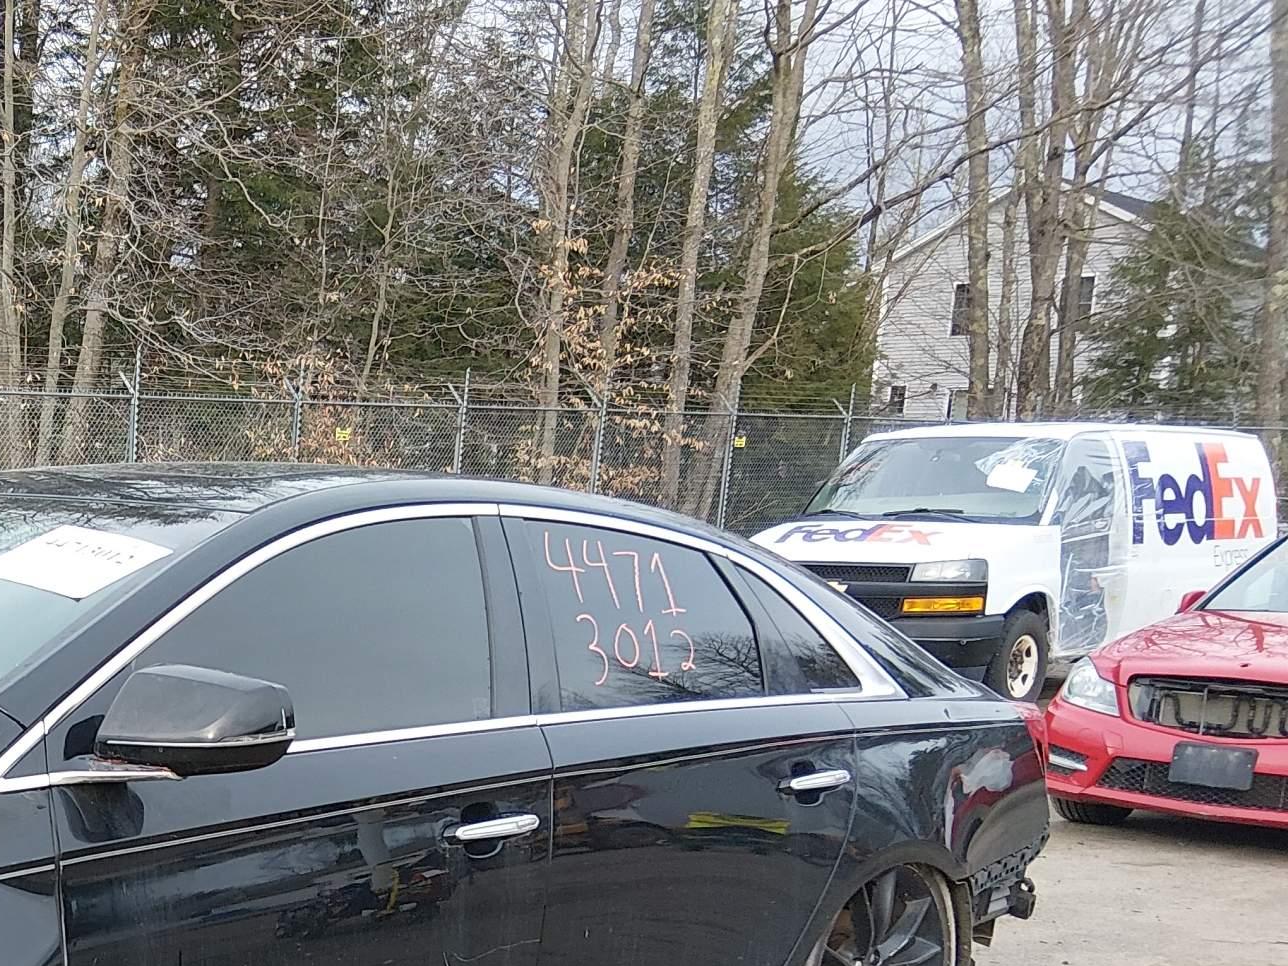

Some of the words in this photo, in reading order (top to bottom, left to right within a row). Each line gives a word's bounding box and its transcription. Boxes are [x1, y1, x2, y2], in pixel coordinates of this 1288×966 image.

[1121, 440, 1264, 546] FedEx
[544, 531, 687, 616] 4471
[774, 523, 944, 546] FedEx
[575, 614, 696, 685] 3012
